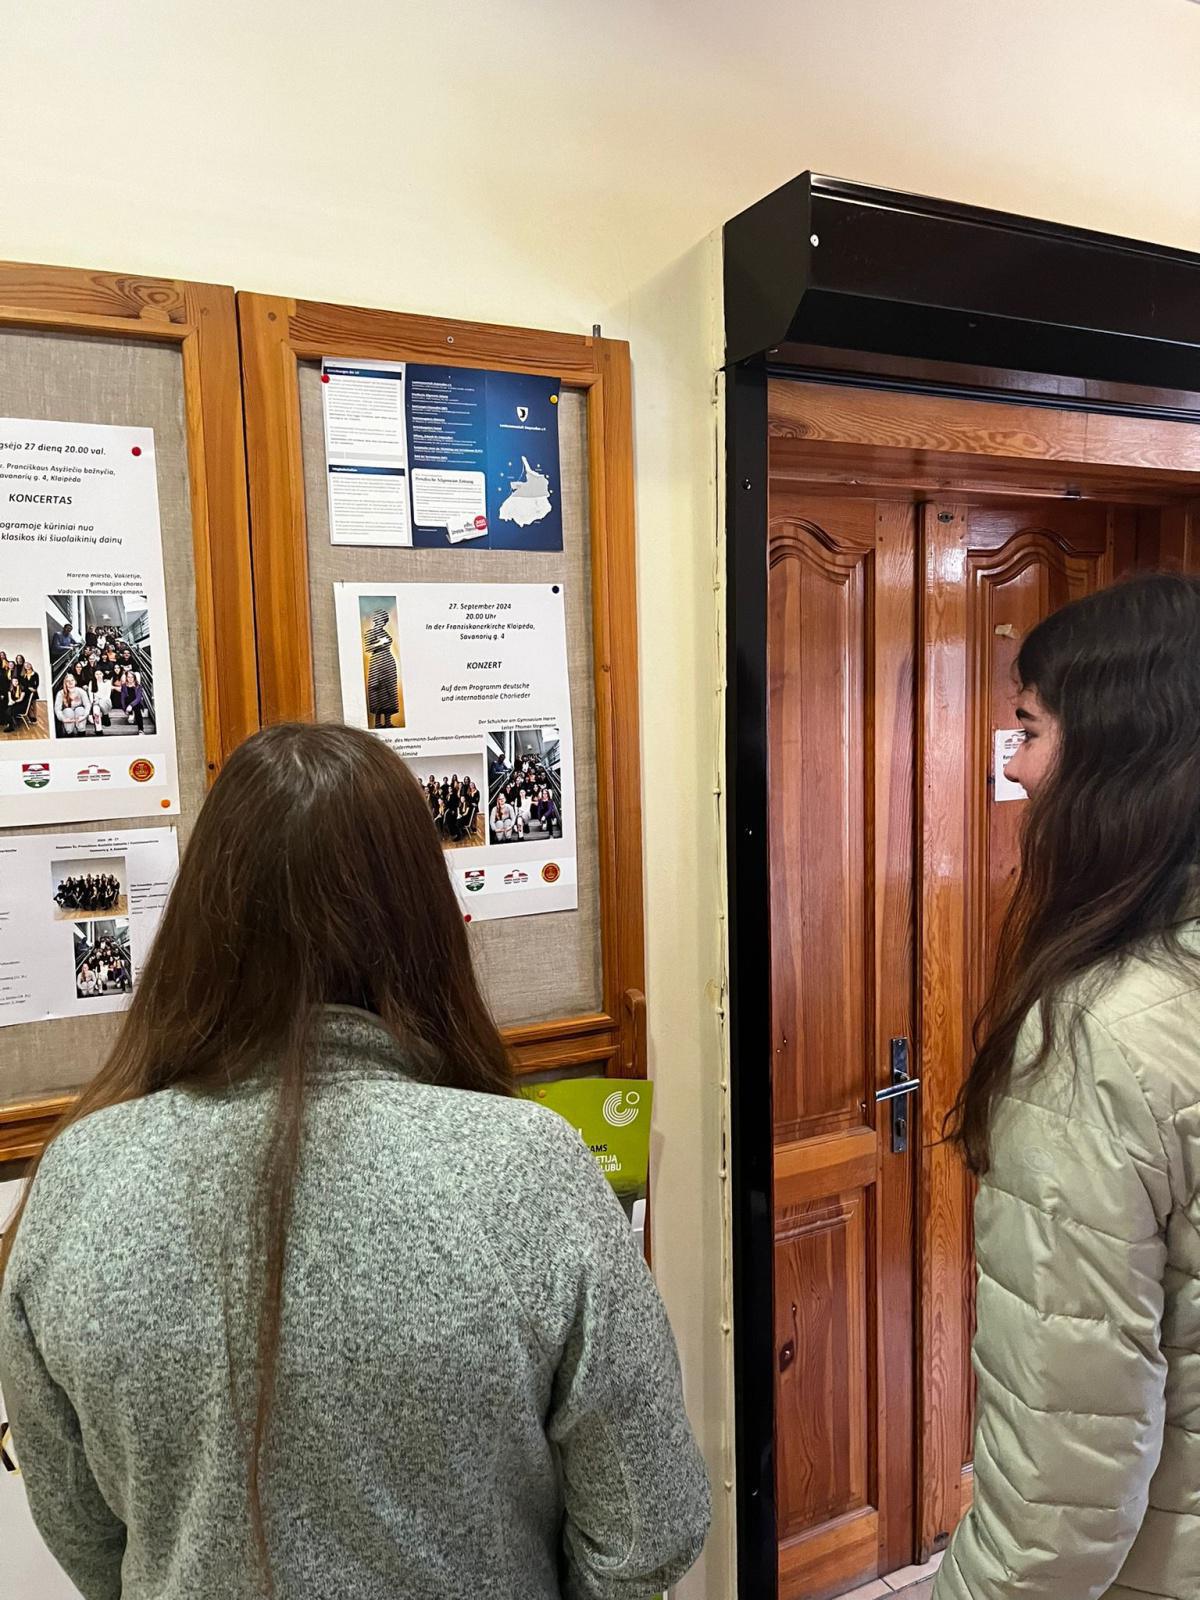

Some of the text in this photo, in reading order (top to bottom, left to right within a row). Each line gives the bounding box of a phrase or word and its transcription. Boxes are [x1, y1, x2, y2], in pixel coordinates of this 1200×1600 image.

[0, 442, 22, 451] gsėjo
[38, 444, 62, 453] dieną
[64, 446, 88, 454] 20.00
[7, 463, 48, 471] Pranciškaus
[9, 493, 72, 504] KONCERTAS
[0, 522, 41, 531] ogramoje
[44, 522, 76, 530] kūriniai
[1, 533, 35, 541] klasikos
[50, 534, 96, 544] šiuolaikinių
[99, 536, 122, 545] dainų
[588, 1144, 608, 1152] AMS
[596, 1155, 617, 1163] ETIJA
[600, 1163, 621, 1172] LUBU
